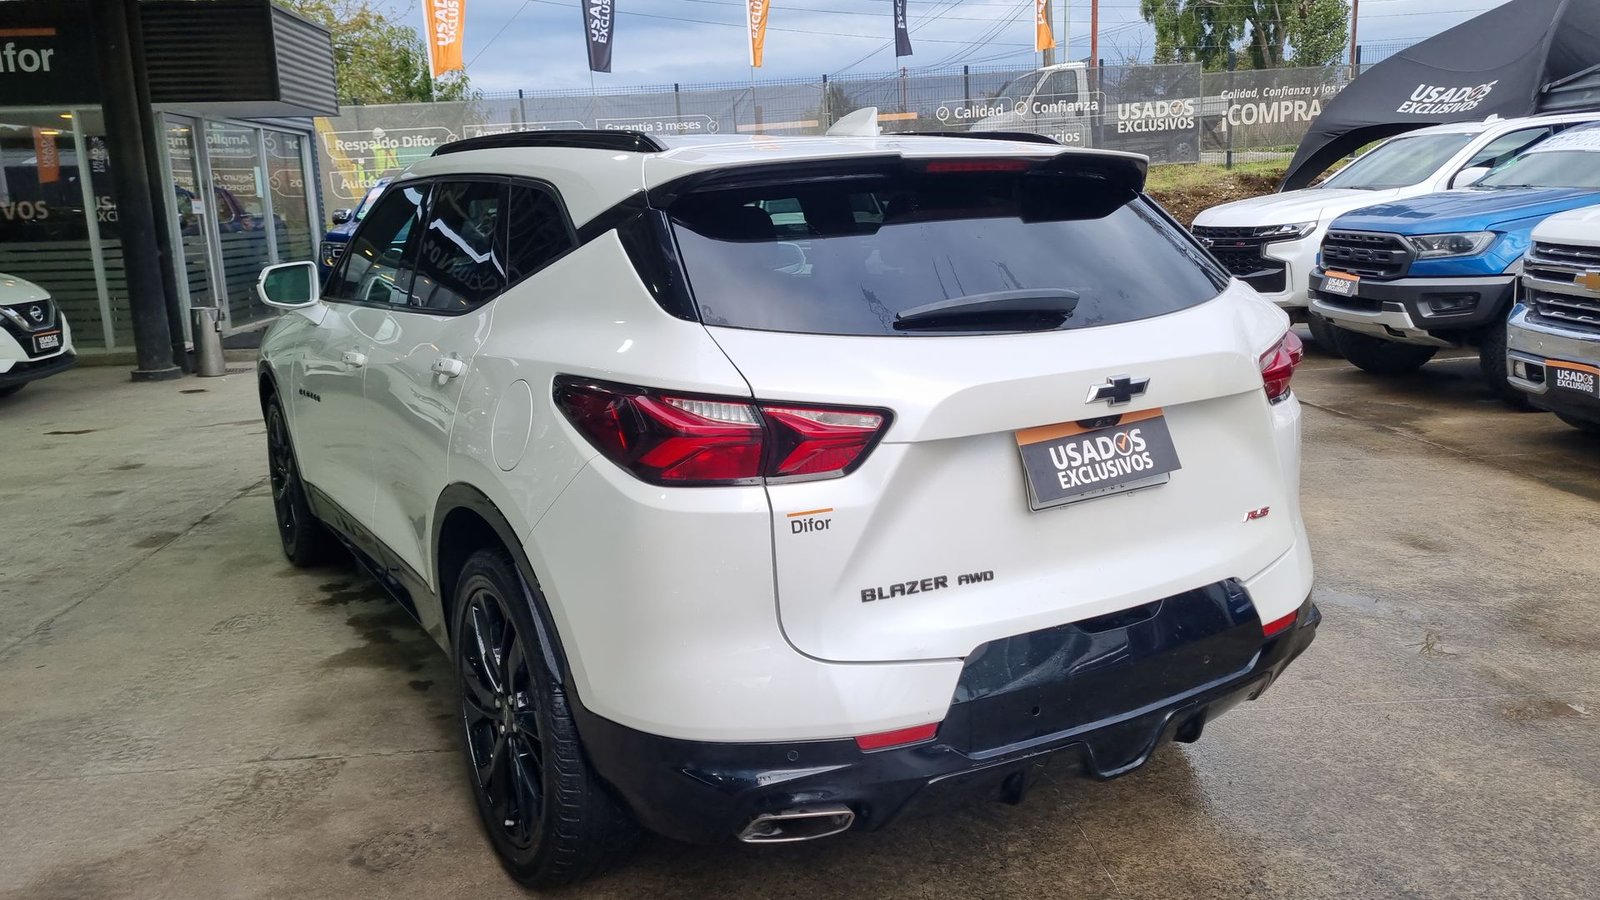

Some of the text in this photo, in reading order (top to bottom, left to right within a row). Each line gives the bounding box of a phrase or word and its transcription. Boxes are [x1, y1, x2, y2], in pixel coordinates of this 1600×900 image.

[1220, 87, 1260, 99] Calidad,
[1263, 85, 1311, 98] Confianza
[1312, 86, 1320, 96] y
[1321, 83, 1337, 94] los
[1410, 80, 1498, 103] USADOS
[954, 104, 1004, 119] Calidad
[1032, 100, 1099, 114] Confianza
[1117, 99, 1194, 120] USADOS
[1396, 98, 1483, 114] EXCLUSIVOS
[655, 121, 663, 131] 3
[665, 120, 701, 131] meses
[1117, 116, 1195, 133] EXCLUSIVOS
[335, 134, 437, 153] Respaldo Difor
[1557, 369, 1594, 385] USADOS
[1557, 379, 1594, 393] EXCLUSIVOS
[1049, 428, 1147, 470] USADOS
[1057, 451, 1154, 490] EXCLUSIVOS
[790, 517, 832, 534] Difor
[860, 570, 994, 603] BLAZER AWD
